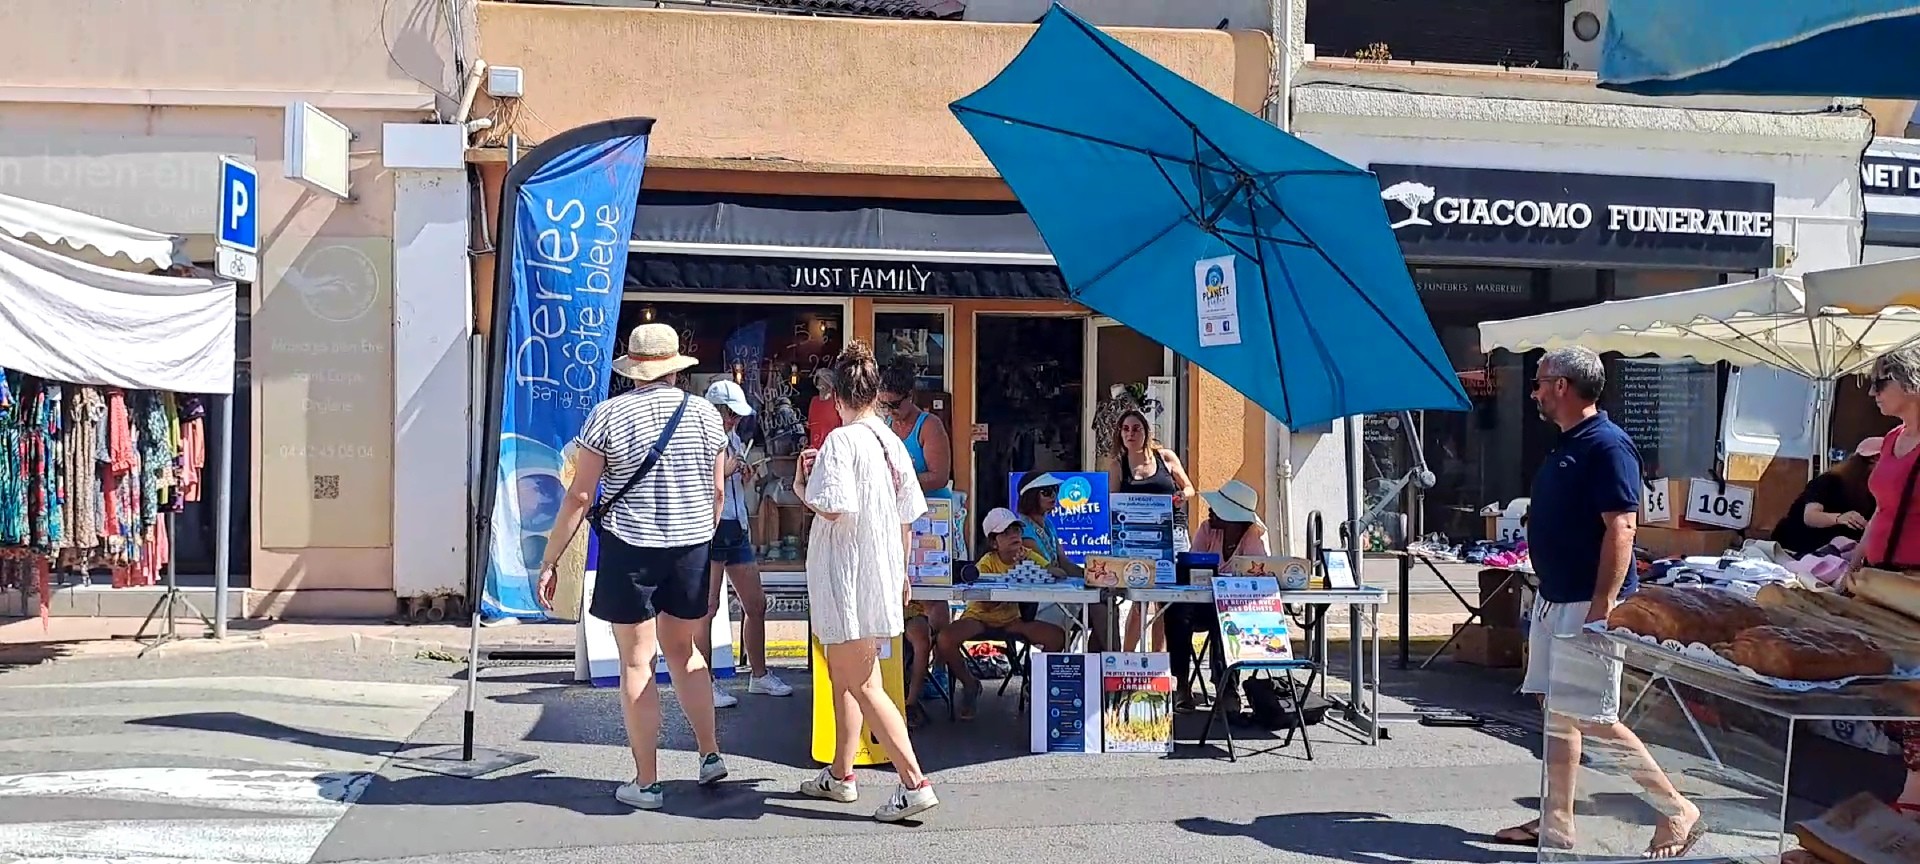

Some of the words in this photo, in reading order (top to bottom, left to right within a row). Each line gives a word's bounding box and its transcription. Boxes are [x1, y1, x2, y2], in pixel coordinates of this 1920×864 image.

[231, 179, 248, 229] P
[1433, 197, 1593, 229] GIACOMO
[1608, 204, 1773, 237] FUNERAIRE
[575, 204, 621, 294] bleue
[517, 198, 586, 387] Perles
[790, 267, 843, 288] JUST
[850, 263, 932, 292] FAMILY
[563, 306, 604, 392] Côte
[1698, 494, 1744, 519] 10€
